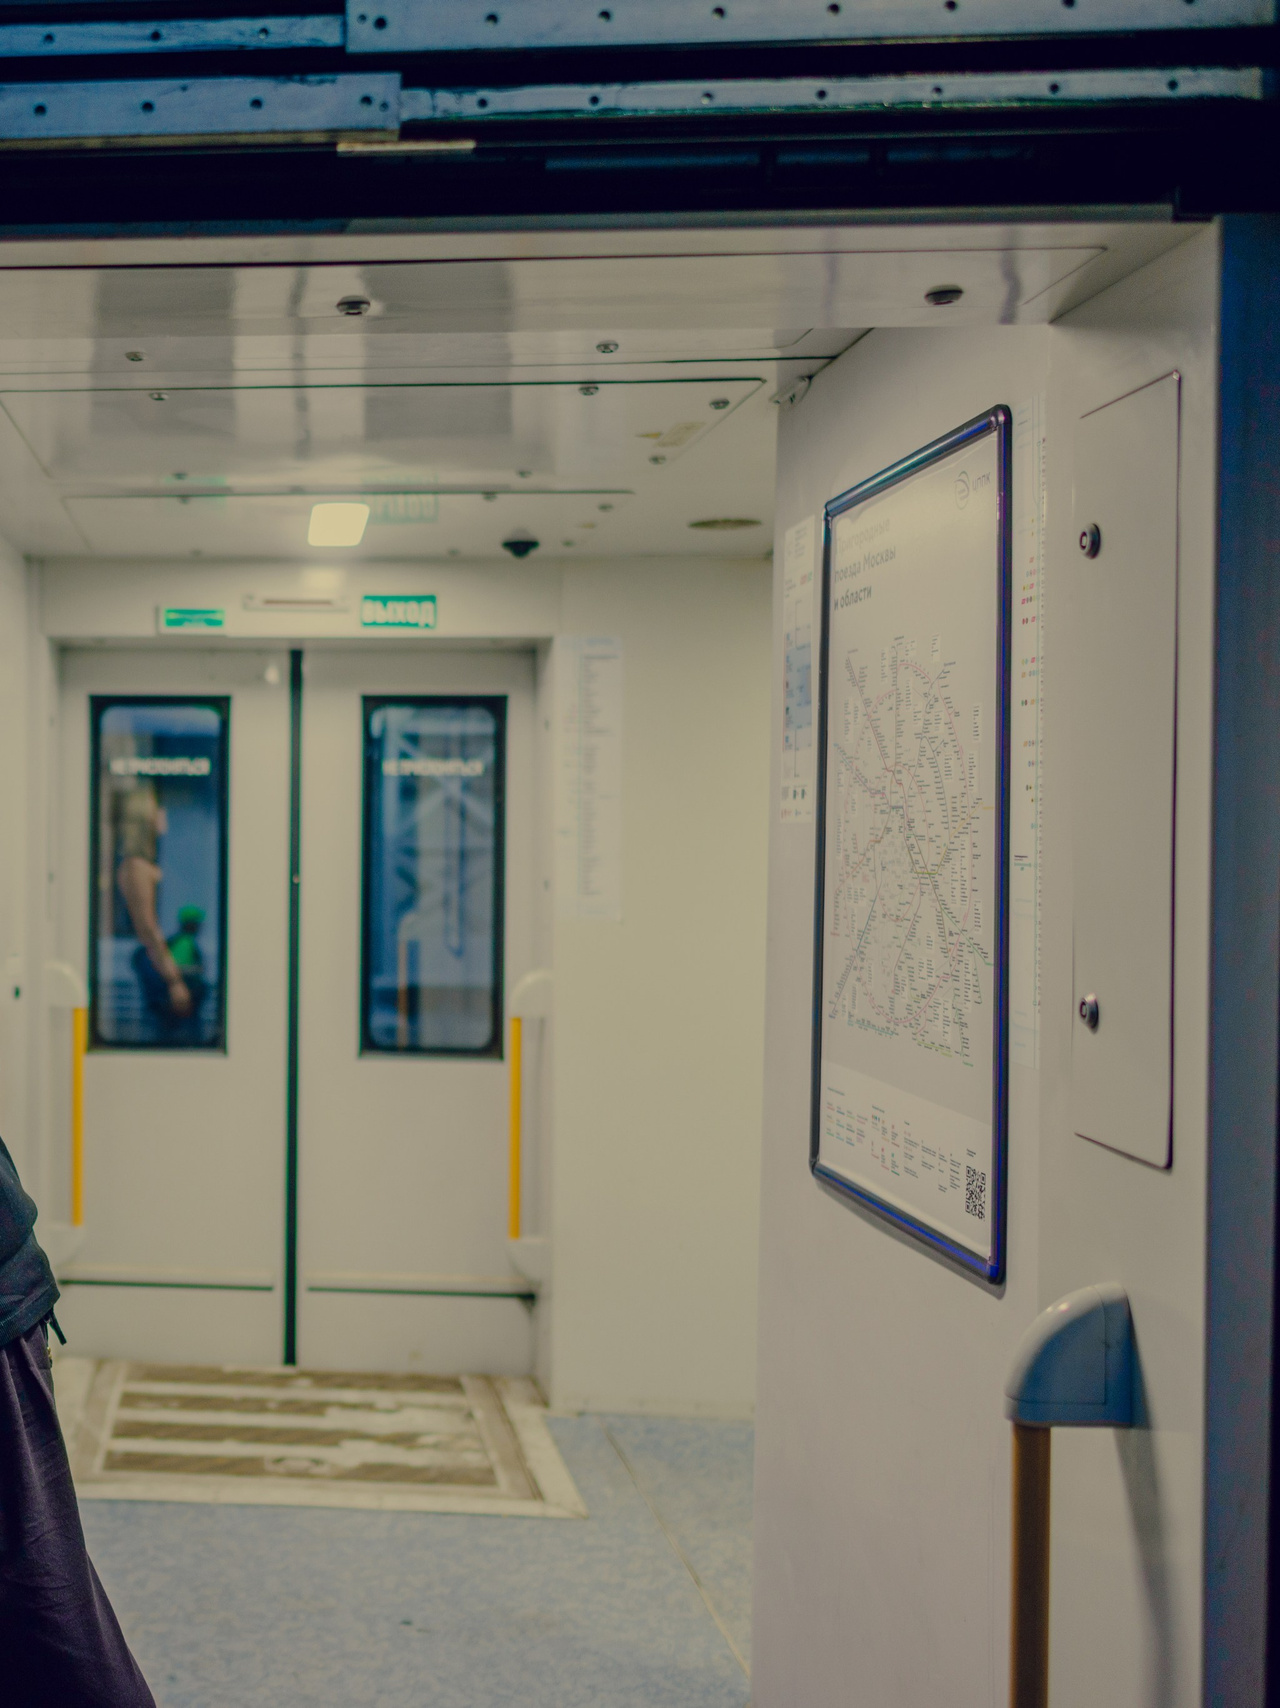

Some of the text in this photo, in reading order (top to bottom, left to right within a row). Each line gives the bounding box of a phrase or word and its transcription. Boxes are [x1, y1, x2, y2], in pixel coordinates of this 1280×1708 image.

[834, 545, 896, 583] поезда Москвы
[840, 585, 872, 608] области
